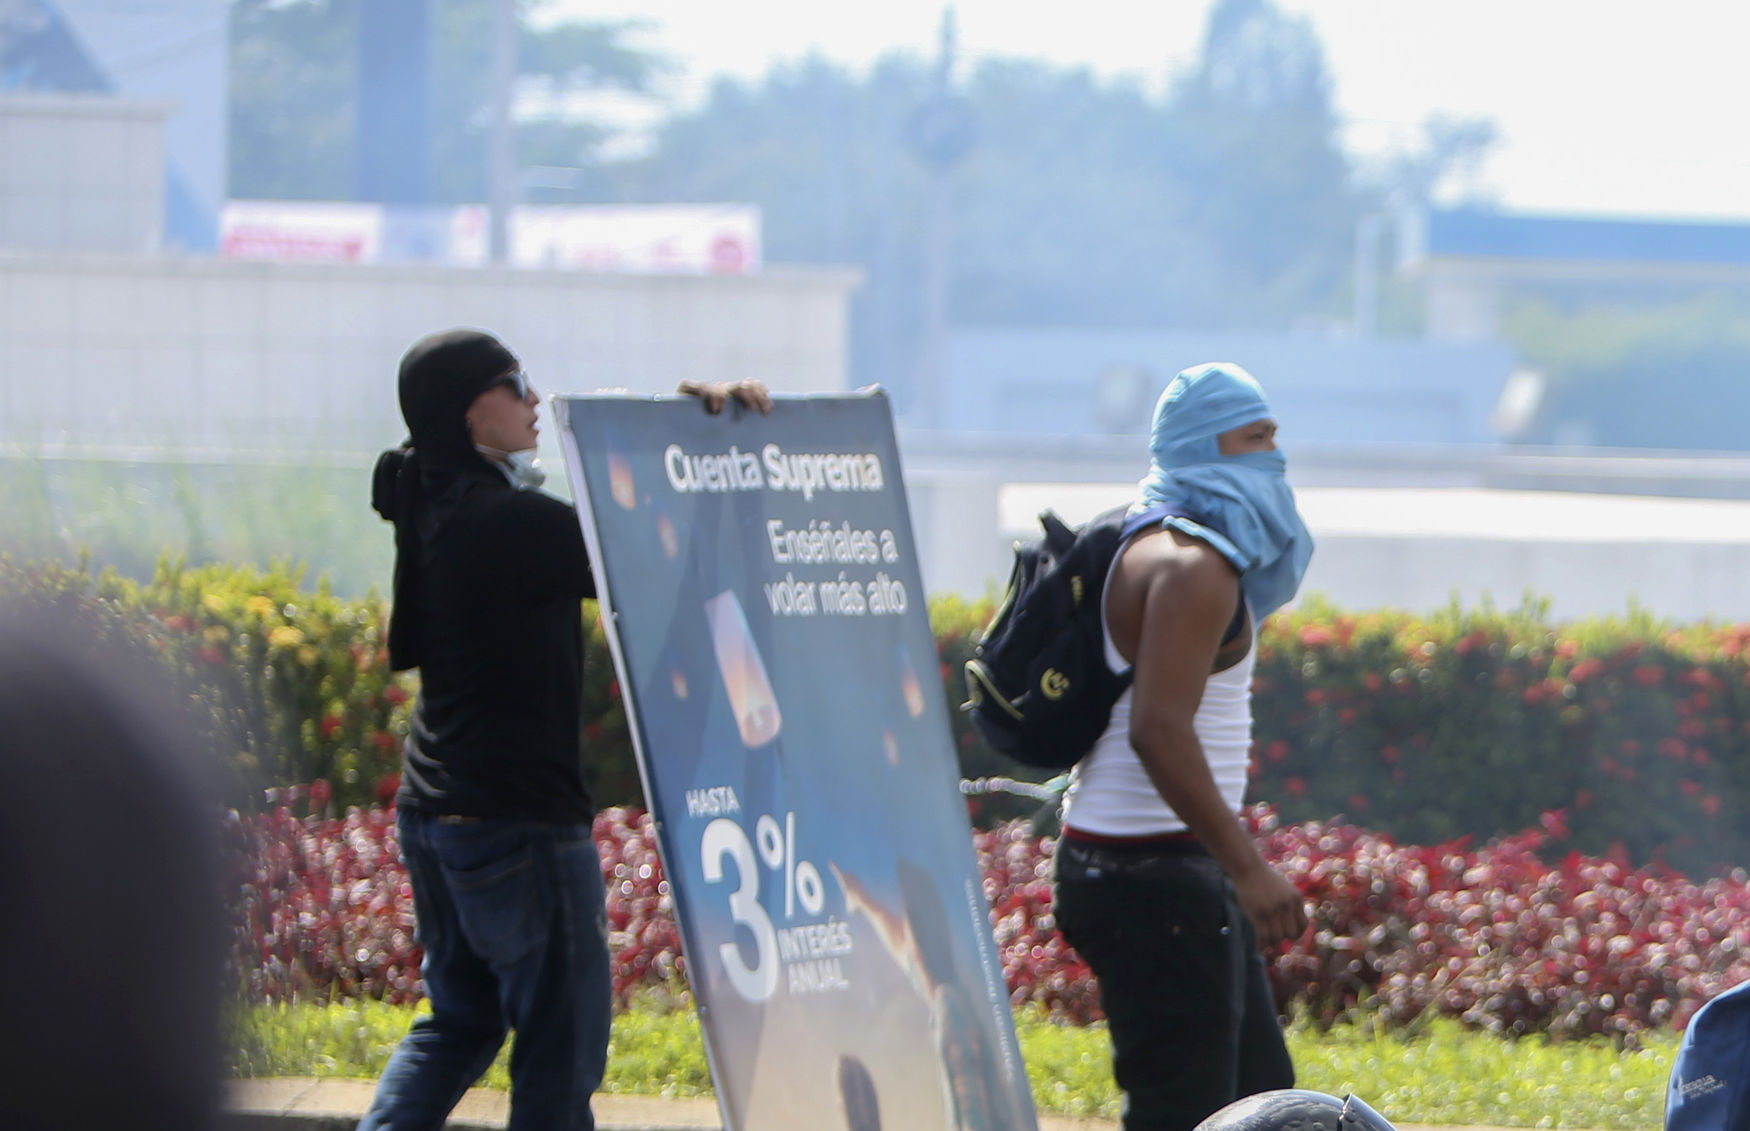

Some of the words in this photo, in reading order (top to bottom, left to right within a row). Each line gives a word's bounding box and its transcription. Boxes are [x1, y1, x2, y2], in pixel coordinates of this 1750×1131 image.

[665, 444, 763, 493] Cuenta
[762, 443, 884, 502] Suprema
[766, 519, 880, 564] Enséñales
[879, 528, 899, 564] a
[763, 570, 818, 616] volar
[819, 570, 868, 616] más
[867, 571, 908, 616] alto
[685, 785, 741, 818] HASTA
[700, 811, 825, 1004] 3%
[777, 915, 853, 964] INTERÉS
[788, 957, 849, 994] ANUAL
